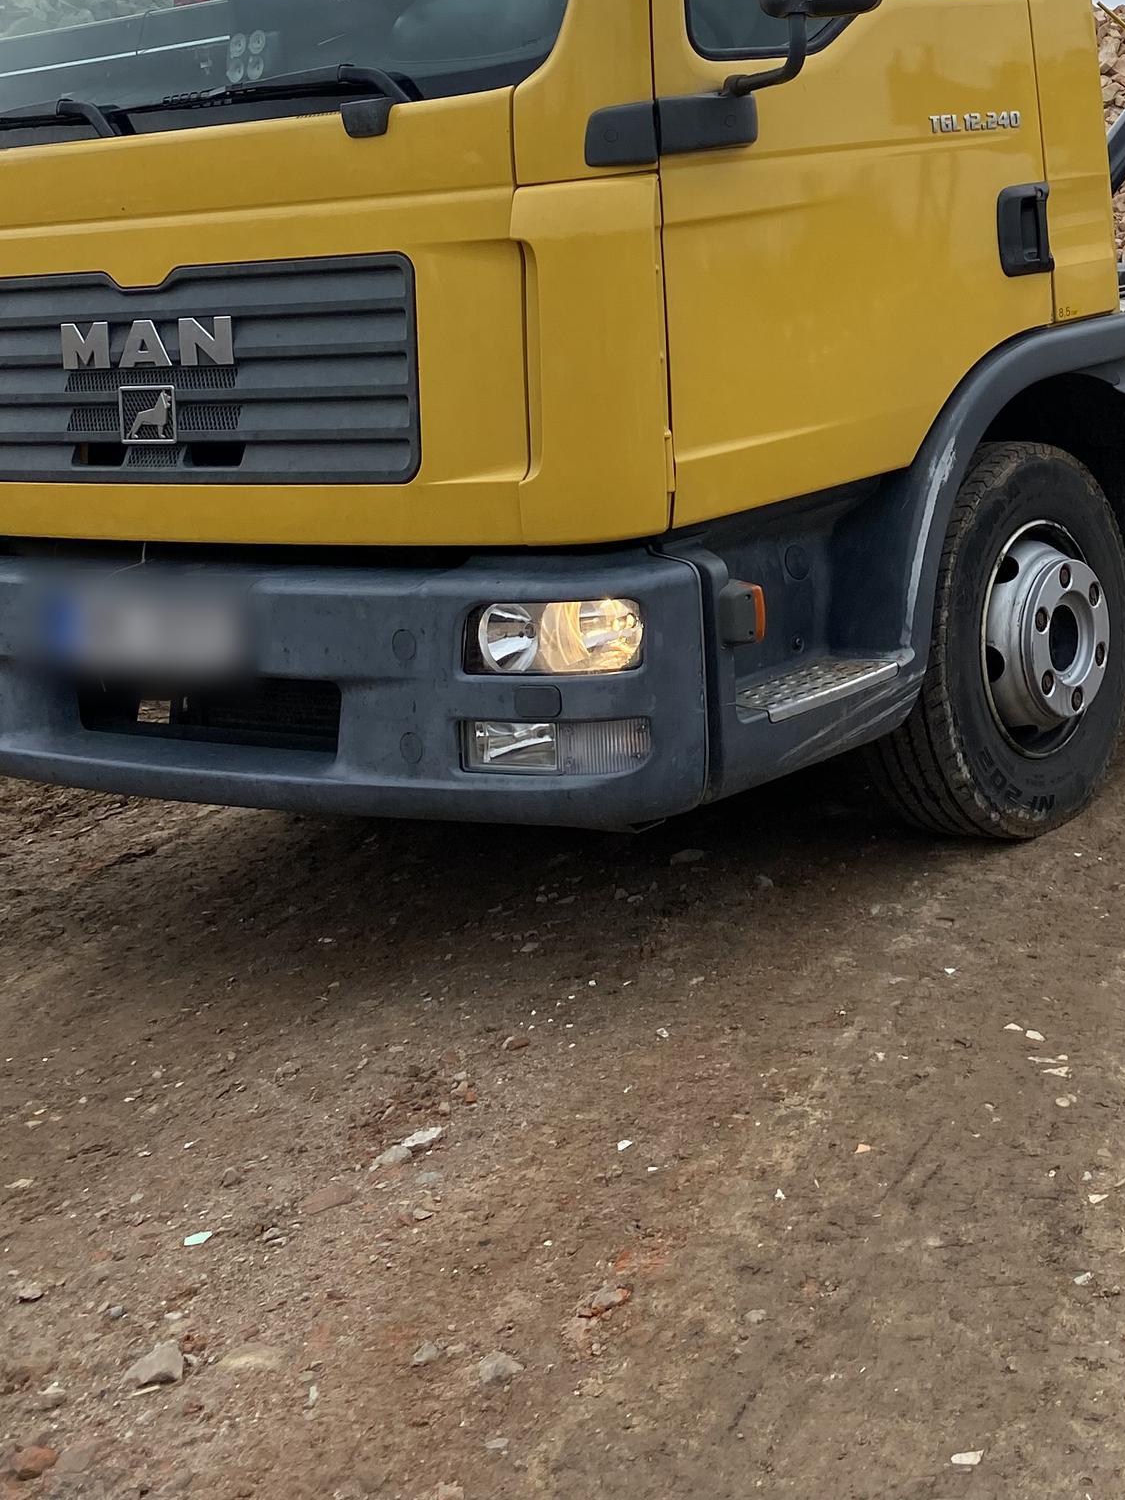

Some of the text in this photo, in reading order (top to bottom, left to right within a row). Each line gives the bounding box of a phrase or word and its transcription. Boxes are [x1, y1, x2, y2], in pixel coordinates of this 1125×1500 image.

[929, 110, 1021, 133] TGL 12.240
[60, 316, 235, 370] MAN
